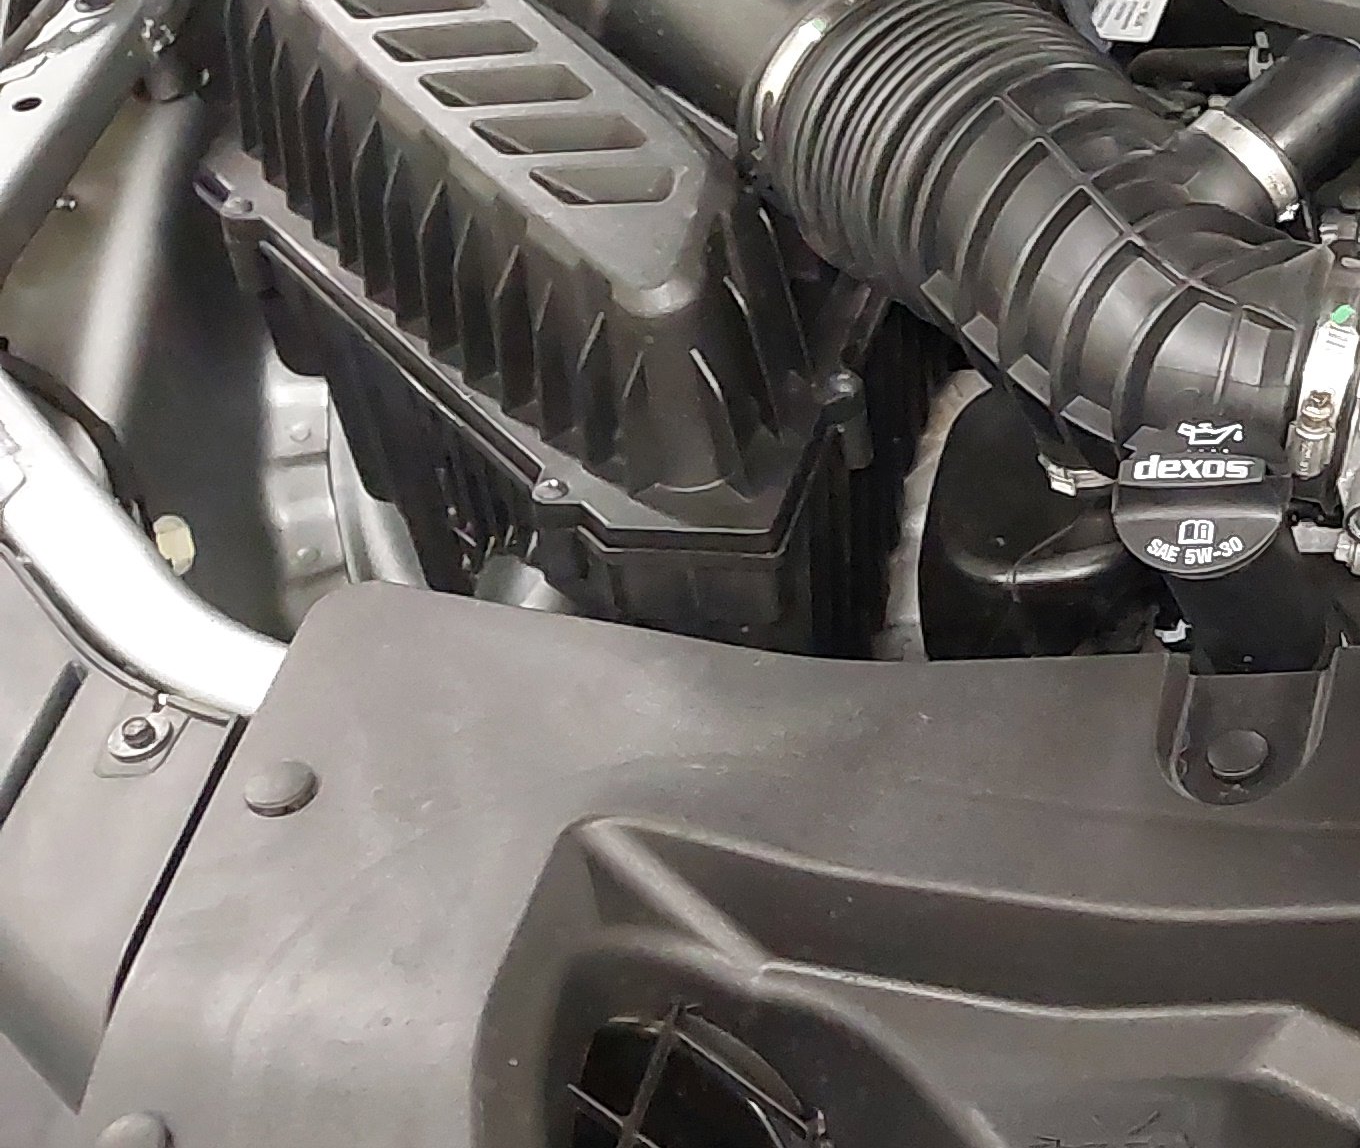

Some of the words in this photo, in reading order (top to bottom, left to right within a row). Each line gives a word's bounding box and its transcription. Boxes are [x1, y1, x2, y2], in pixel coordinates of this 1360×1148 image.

[1133, 454, 1256, 480] dexos
[1147, 538, 1180, 563] SAE
[1184, 536, 1244, 565] 5W-30
